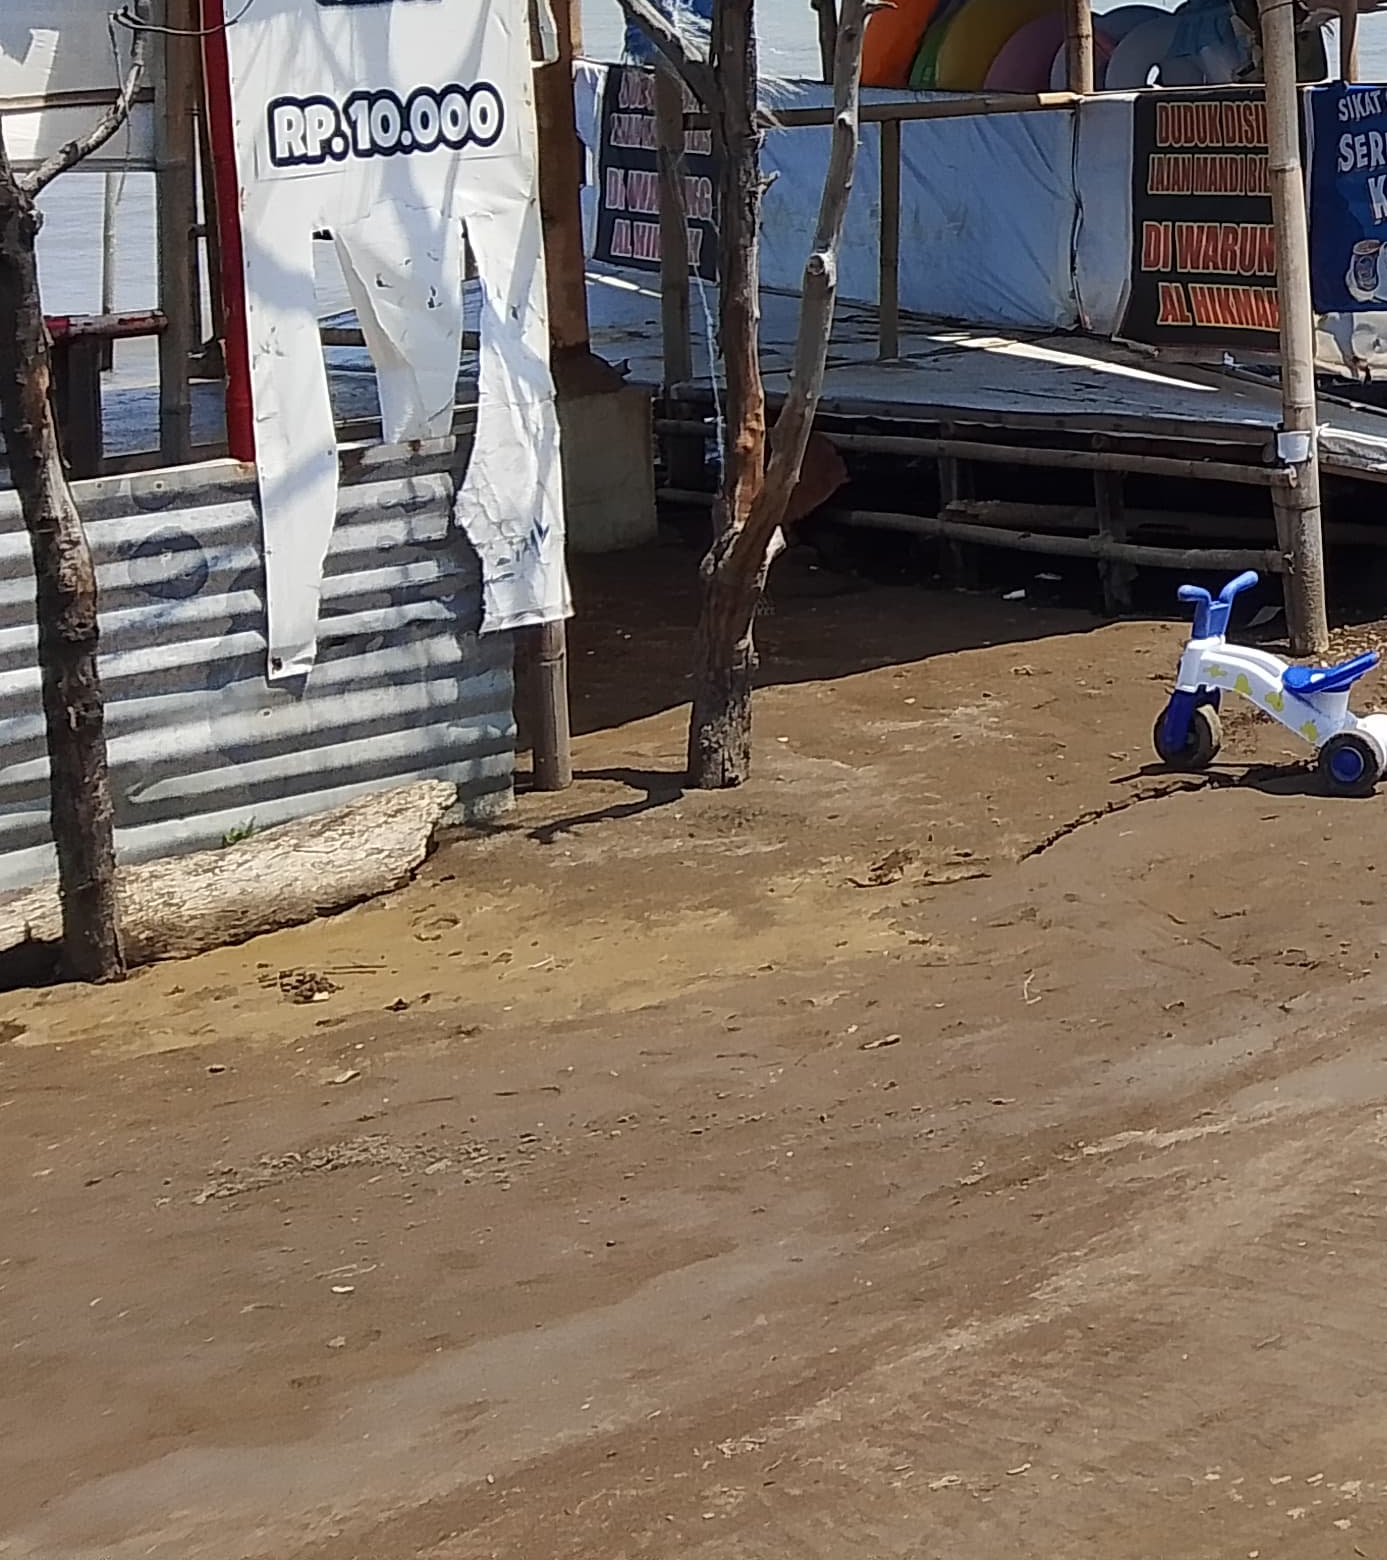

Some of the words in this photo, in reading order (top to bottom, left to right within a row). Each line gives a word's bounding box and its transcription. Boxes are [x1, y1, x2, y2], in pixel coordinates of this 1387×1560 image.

[1156, 101, 1223, 147] DUDUK
[1222, 101, 1269, 147] DISI
[1337, 90, 1382, 122] SIKAT
[1147, 154, 1193, 195] JAJAN
[1193, 154, 1246, 196] MANDI
[1246, 154, 1271, 196] BIL
[1141, 221, 1173, 272] DI
[1174, 221, 1278, 276] WARUN
[1156, 281, 1193, 326] AL
